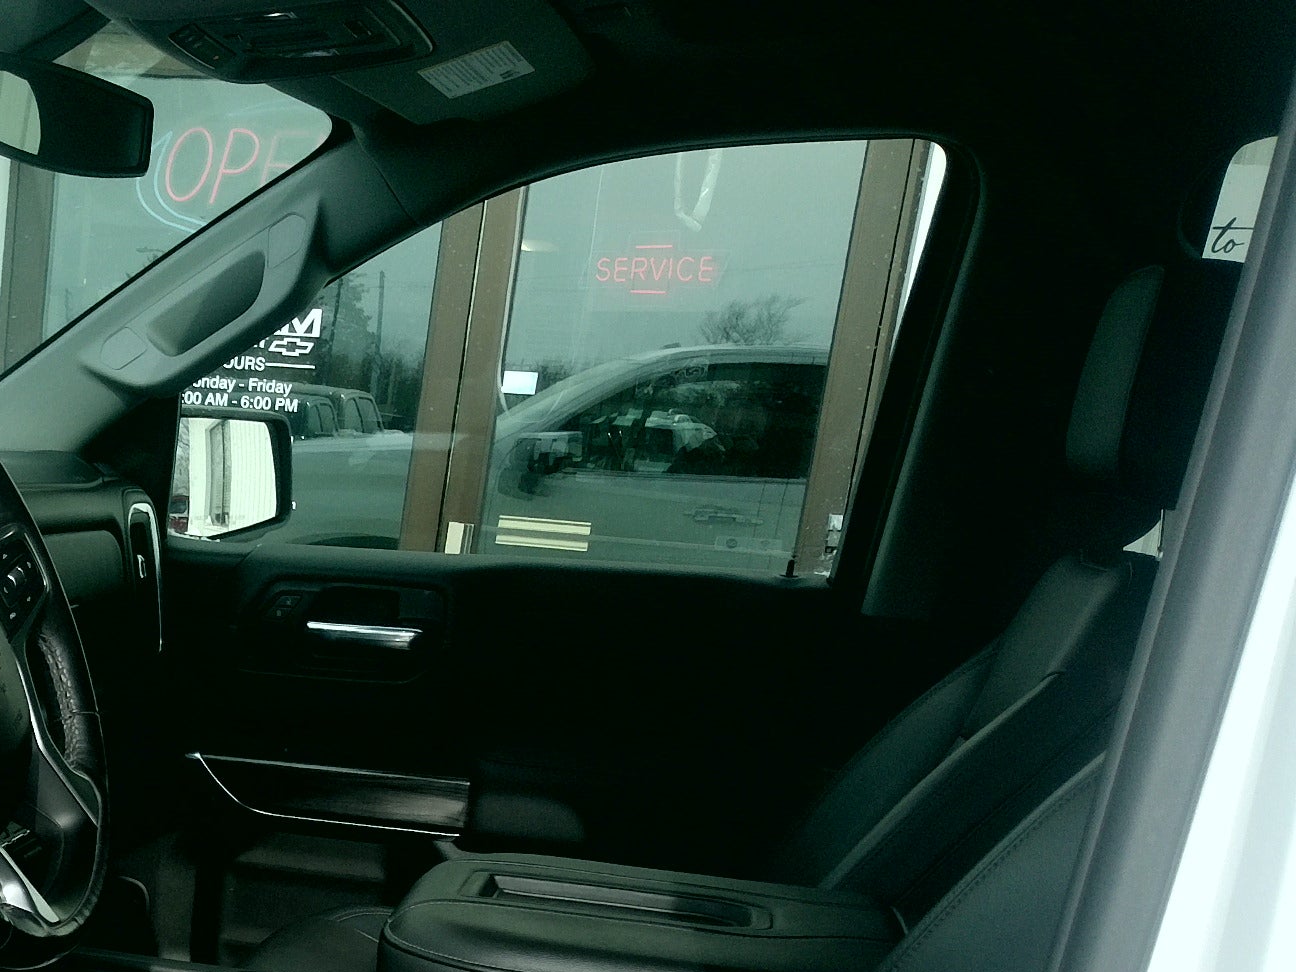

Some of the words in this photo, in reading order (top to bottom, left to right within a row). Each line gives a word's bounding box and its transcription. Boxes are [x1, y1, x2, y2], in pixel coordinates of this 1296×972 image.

[165, 127, 323, 204] OPE
[1211, 216, 1254, 254] to
[595, 256, 714, 282] SERVICE
[248, 377, 293, 398] Friday
[204, 392, 229, 407] AM
[240, 395, 272, 410] 6:00
[274, 397, 299, 413] PM
